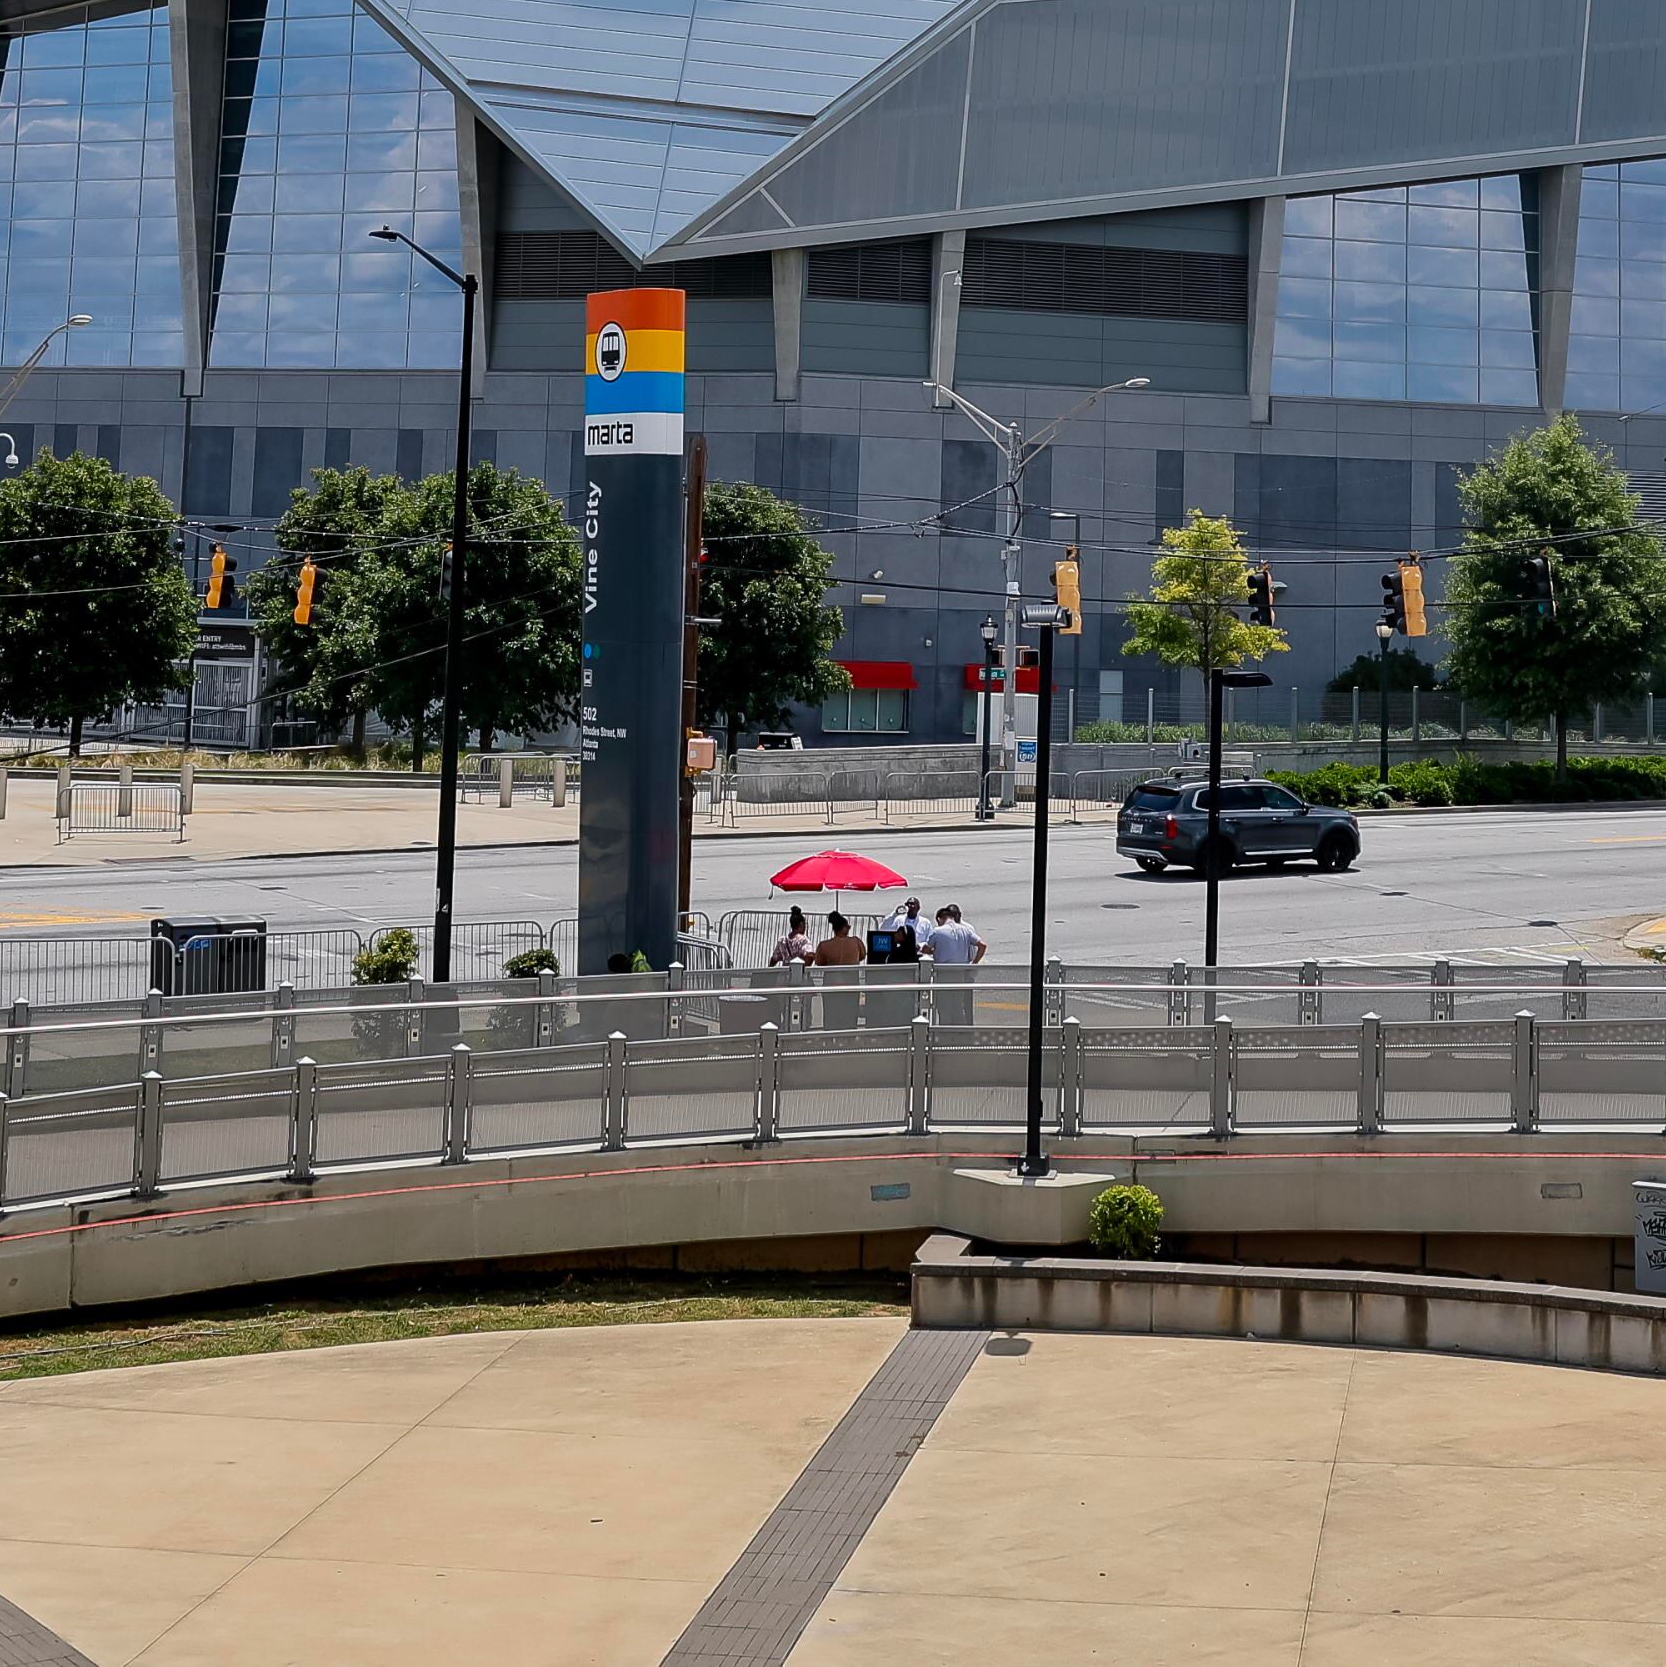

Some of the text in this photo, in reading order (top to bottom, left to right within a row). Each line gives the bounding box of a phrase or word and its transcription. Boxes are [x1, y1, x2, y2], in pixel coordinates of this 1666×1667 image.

[587, 421, 633, 446] marta
[584, 481, 603, 614] Vine City
[582, 706, 598, 722] 502
[616, 728, 627, 738] NW
